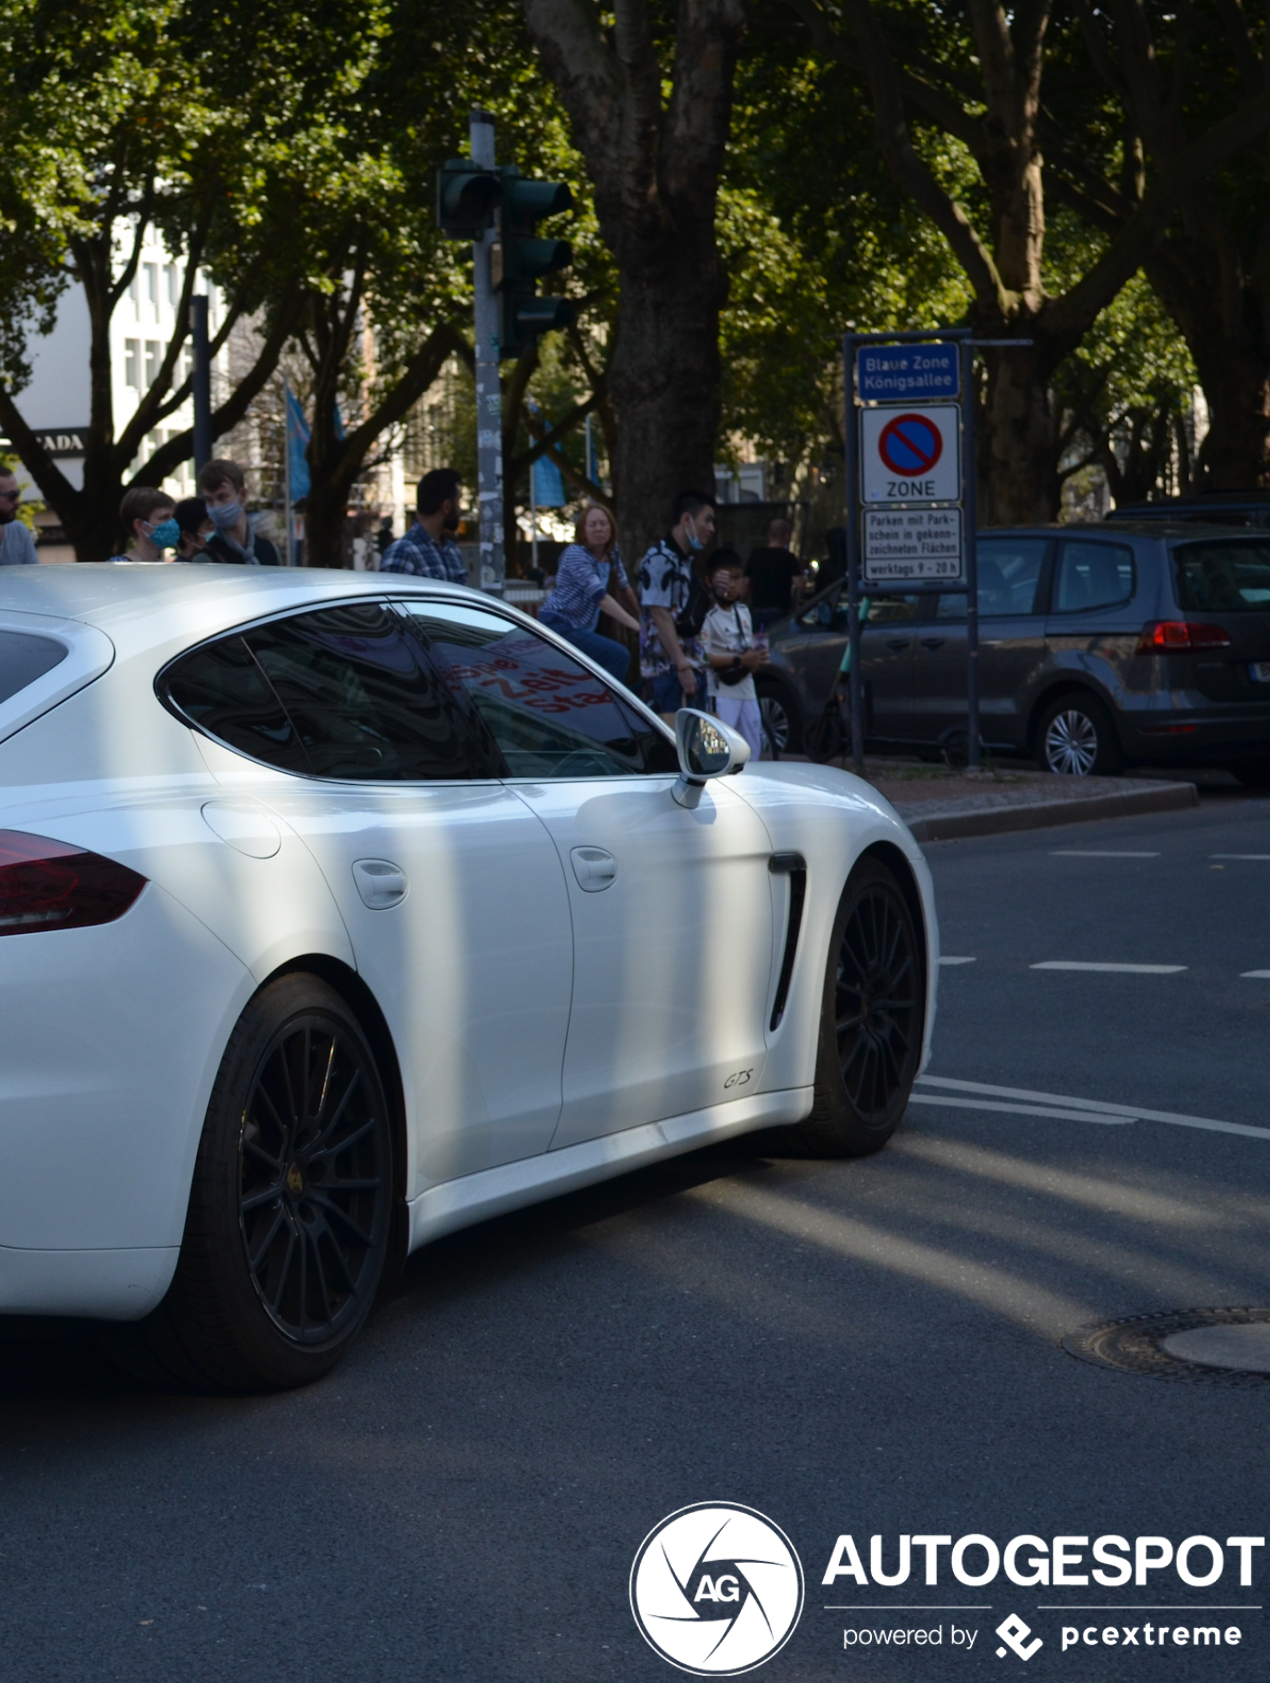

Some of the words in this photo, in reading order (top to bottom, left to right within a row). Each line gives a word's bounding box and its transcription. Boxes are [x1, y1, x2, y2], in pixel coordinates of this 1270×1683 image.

[866, 357, 908, 372] Blaue
[913, 355, 950, 370] Zone
[864, 374, 952, 391] Königsallee
[36, 434, 84, 451] ADA
[887, 480, 936, 498] ZONE
[870, 514, 904, 527] Parken
[907, 514, 924, 526] mit
[927, 513, 955, 526] Park-
[869, 529, 900, 541] schein
[903, 528, 913, 540] in
[916, 528, 957, 542] gekenn-
[869, 541, 918, 555] zeichneten
[921, 540, 957, 553] Flächen
[870, 562, 914, 576] werktags
[918, 562, 925, 574] 9
[936, 562, 948, 573] 20
[949, 561, 957, 573] h
[724, 1068, 754, 1089] GTS
